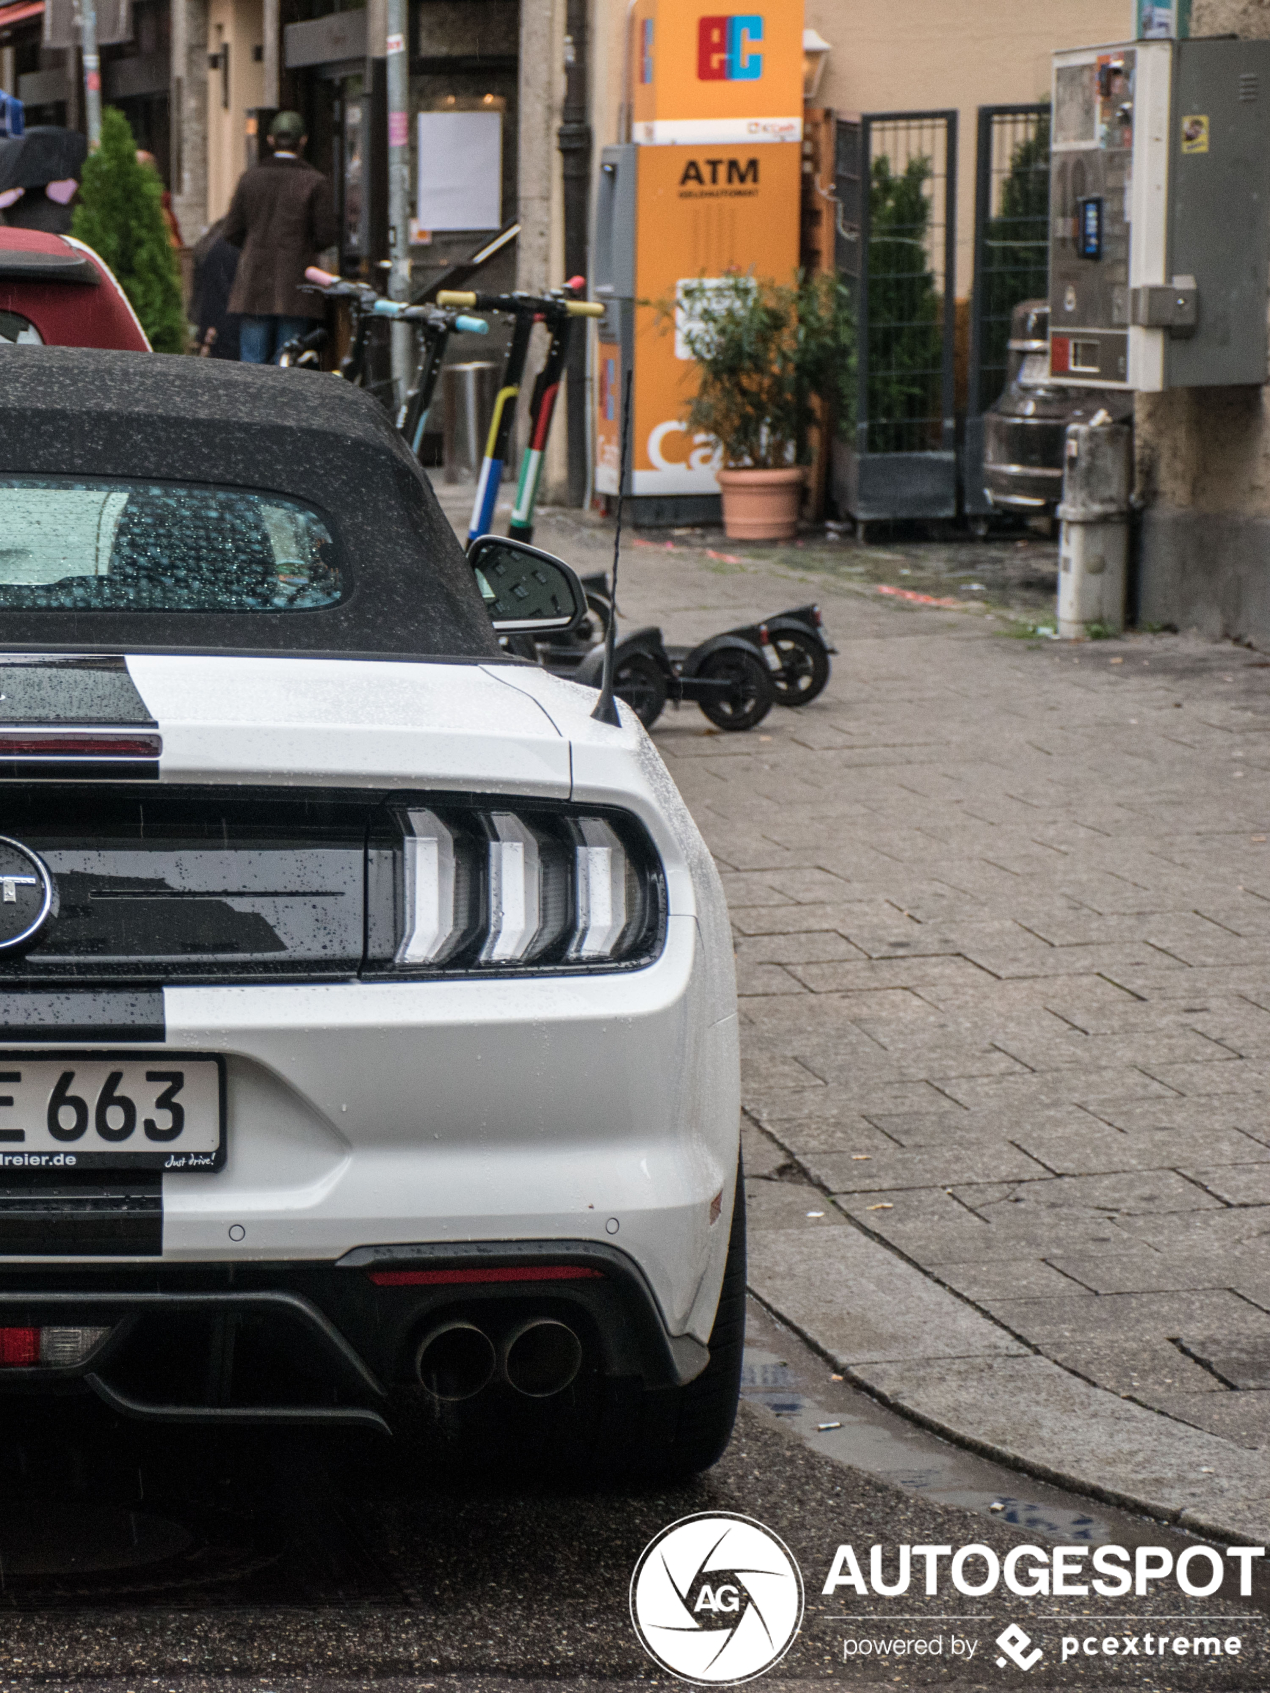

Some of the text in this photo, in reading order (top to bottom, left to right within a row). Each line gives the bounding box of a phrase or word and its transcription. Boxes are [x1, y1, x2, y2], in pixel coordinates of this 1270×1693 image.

[681, 158, 758, 185] ATM
[47, 1071, 185, 1143] 663
[164, 1152, 216, 1168] Just drive!
